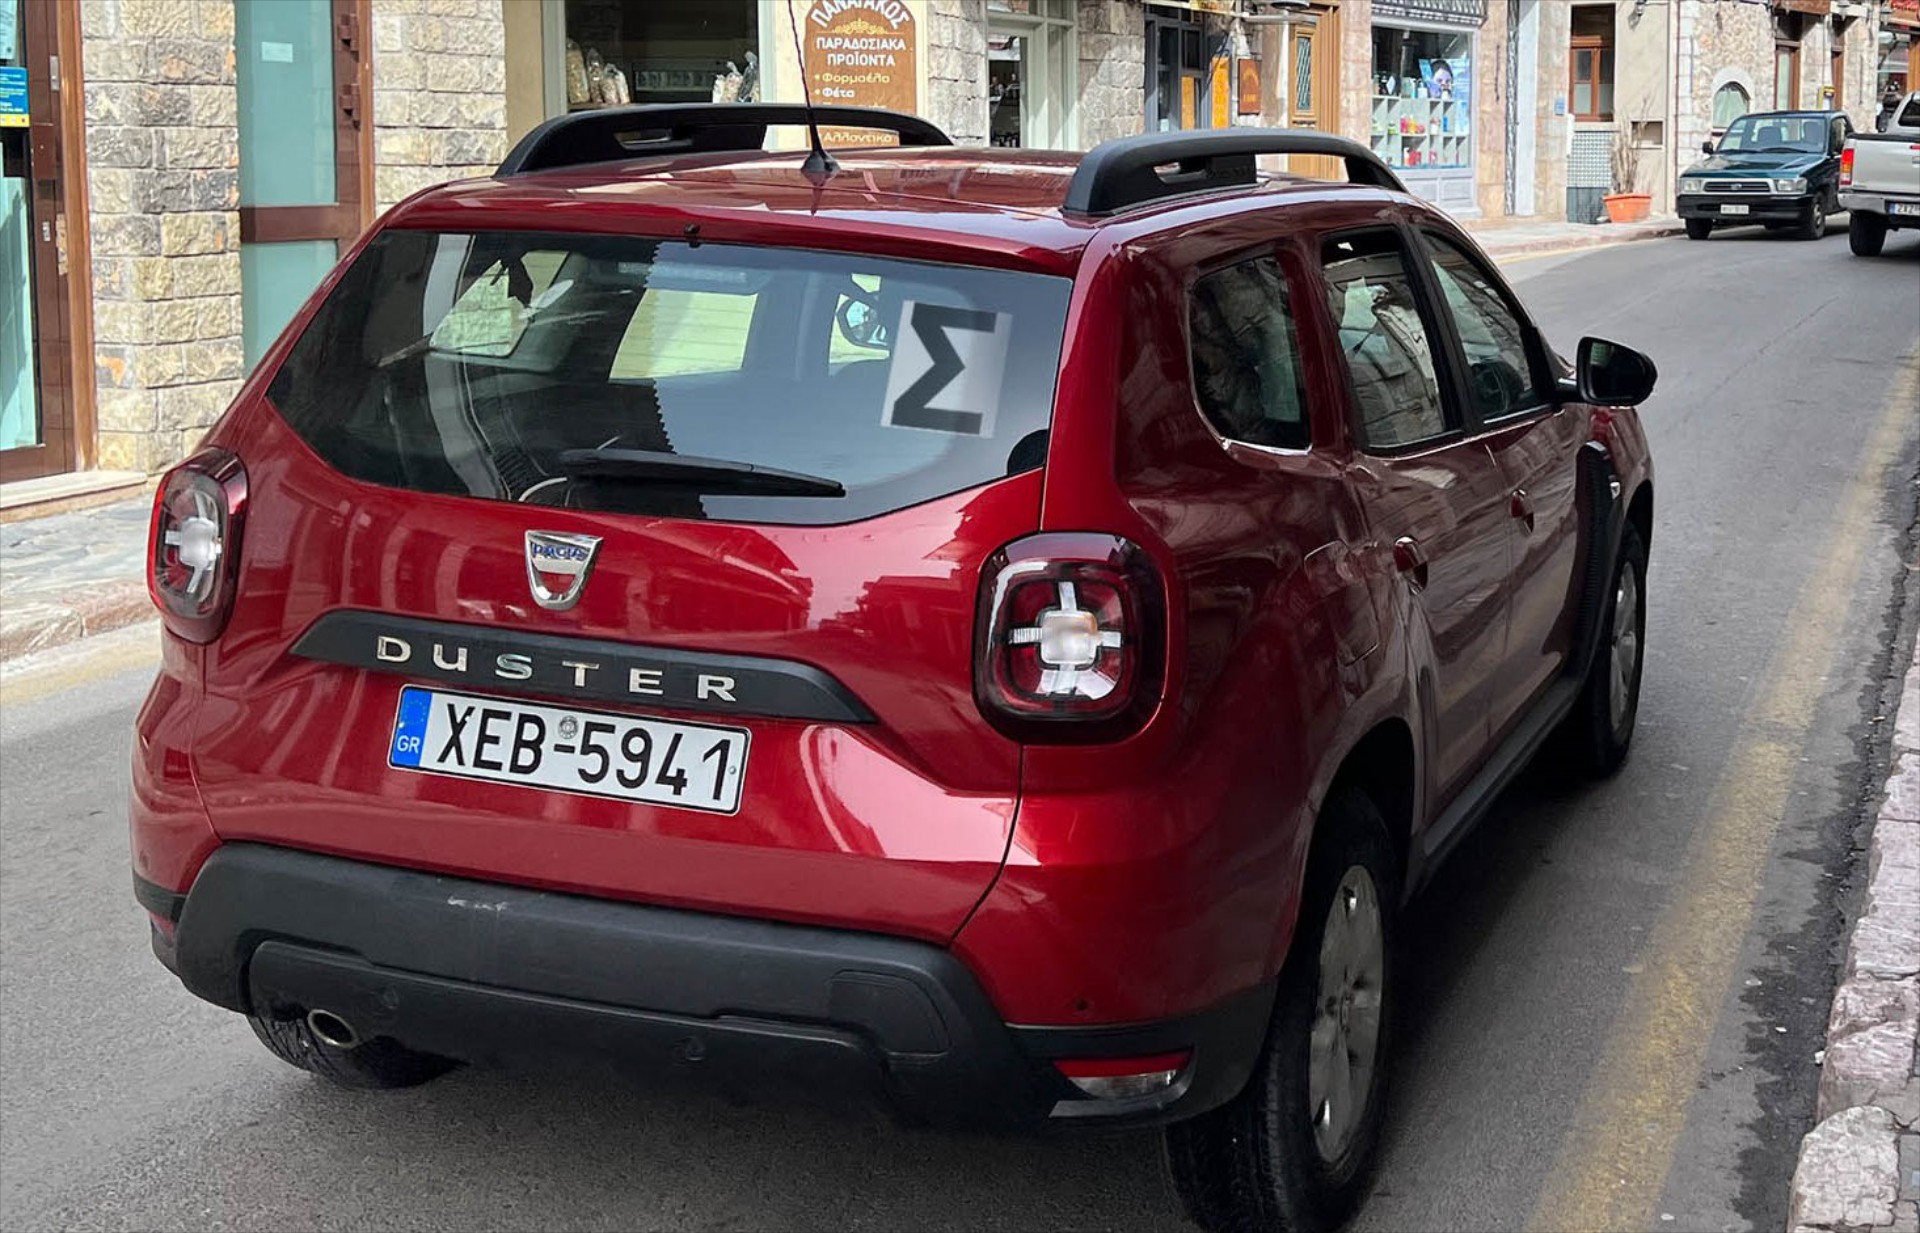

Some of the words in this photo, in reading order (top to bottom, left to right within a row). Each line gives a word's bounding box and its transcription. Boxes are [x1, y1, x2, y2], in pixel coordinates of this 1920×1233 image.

[816, 37, 906, 50] ΠΑΡΑΔΟΣΙΑΚΑ
[827, 51, 896, 66] ΠΡΟΪΟΝΤΑ
[822, 86, 855, 98] Φέτα
[891, 302, 997, 435] Σ
[376, 635, 737, 701] DUSTER
[396, 734, 421, 753] GR
